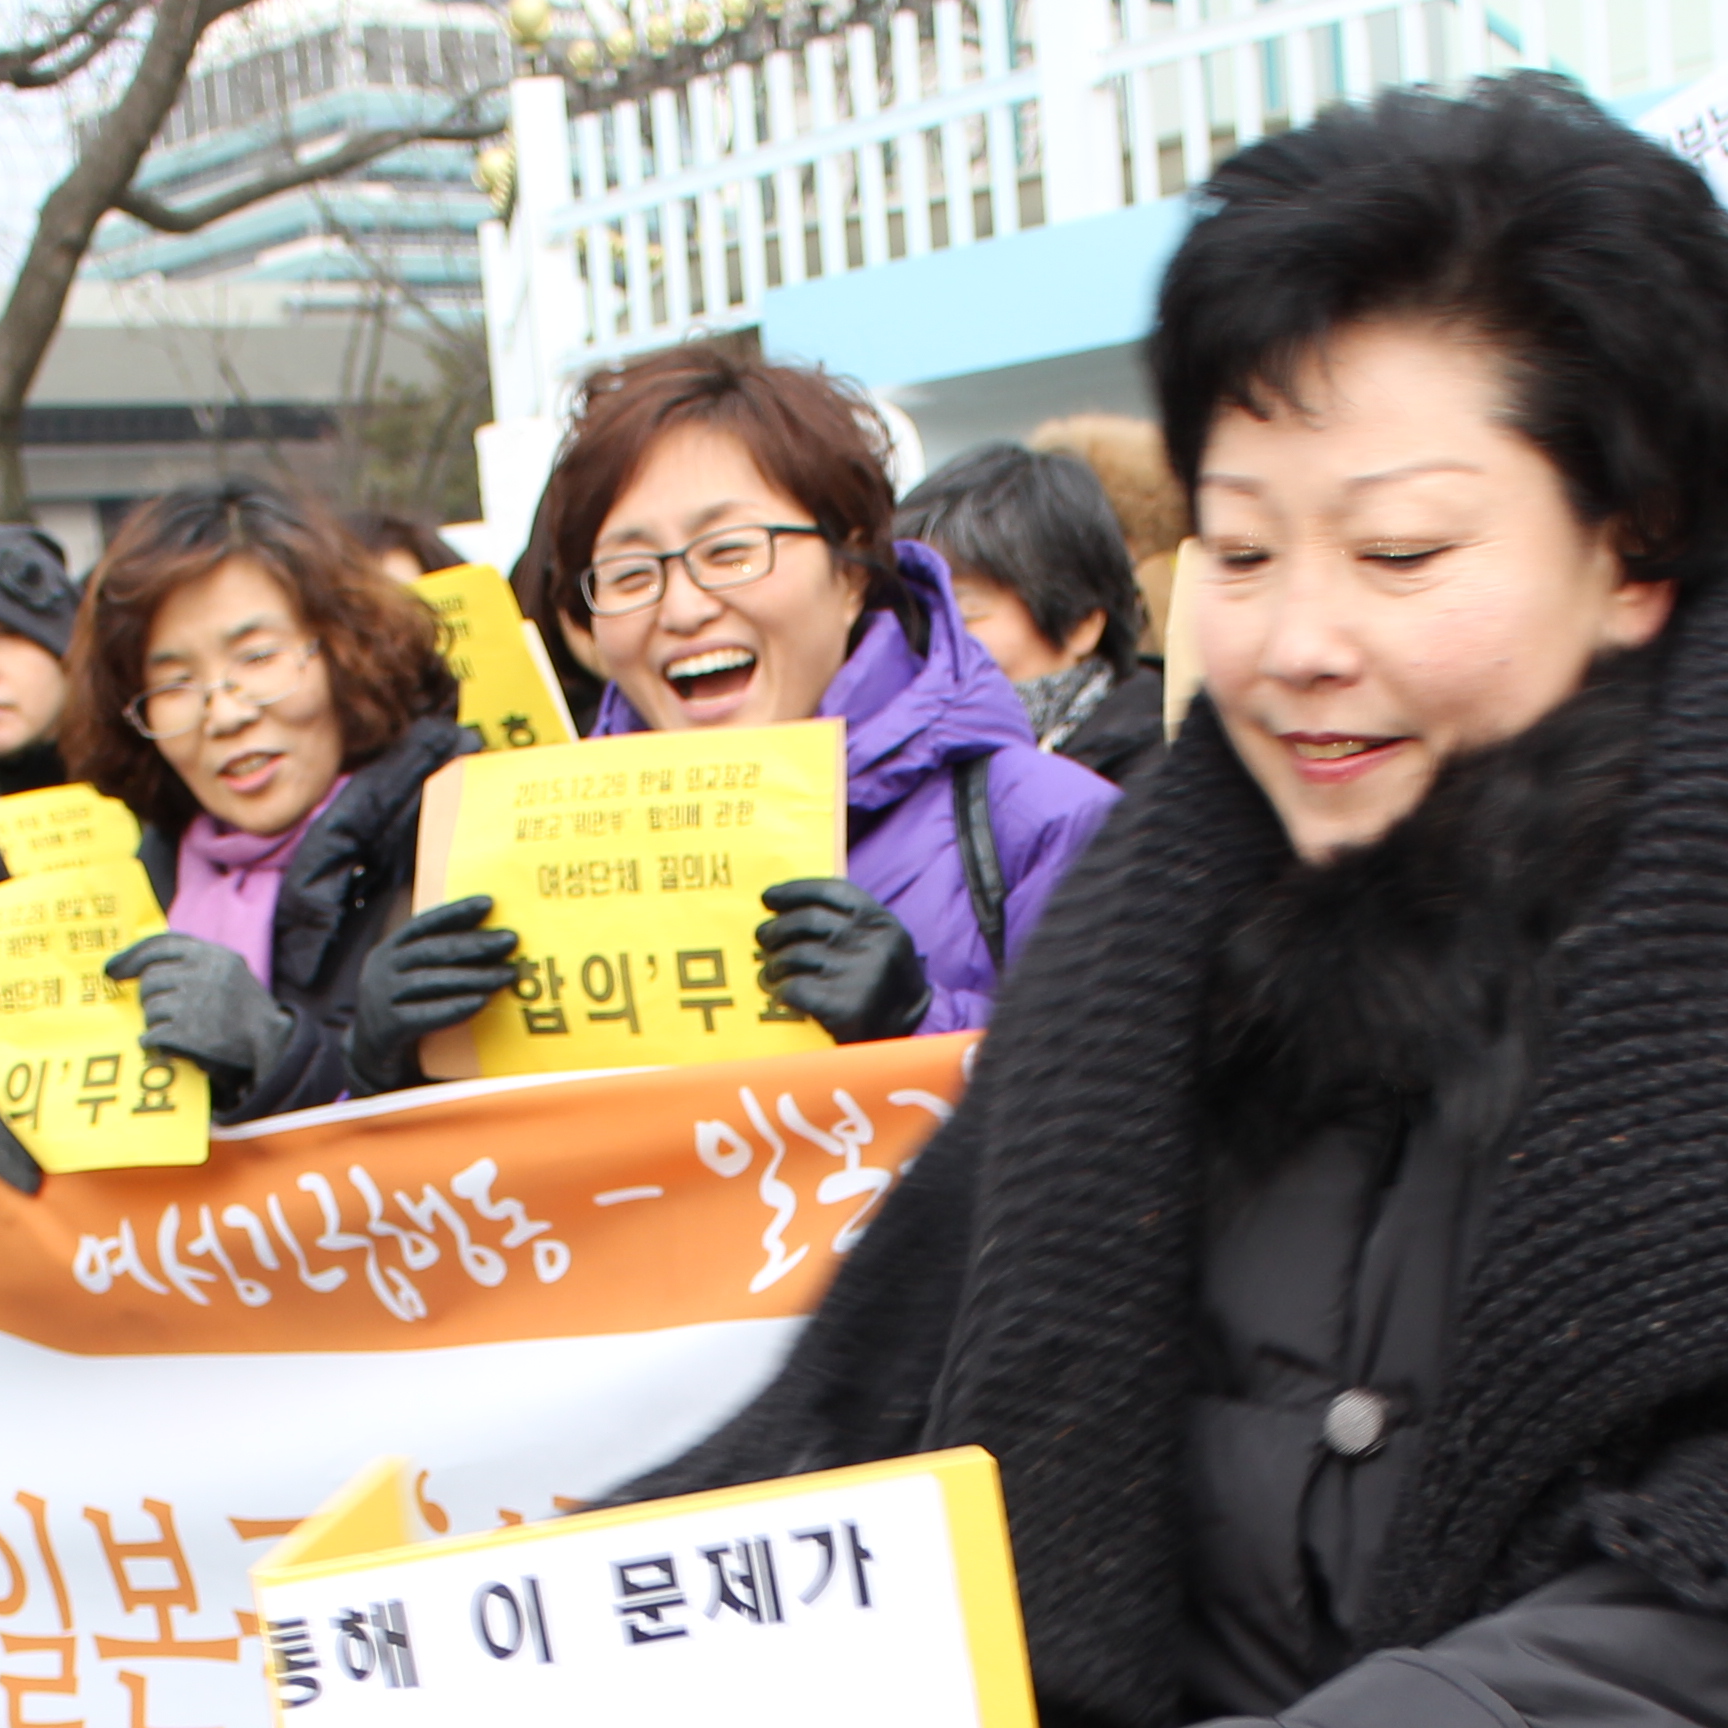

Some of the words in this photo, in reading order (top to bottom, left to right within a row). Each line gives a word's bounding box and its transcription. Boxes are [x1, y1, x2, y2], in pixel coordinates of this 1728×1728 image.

[537, 855, 642, 899] 여성단체
[658, 852, 734, 893] 질의서
[471, 1573, 556, 1666] 이
[609, 1516, 875, 1647] 문제가
